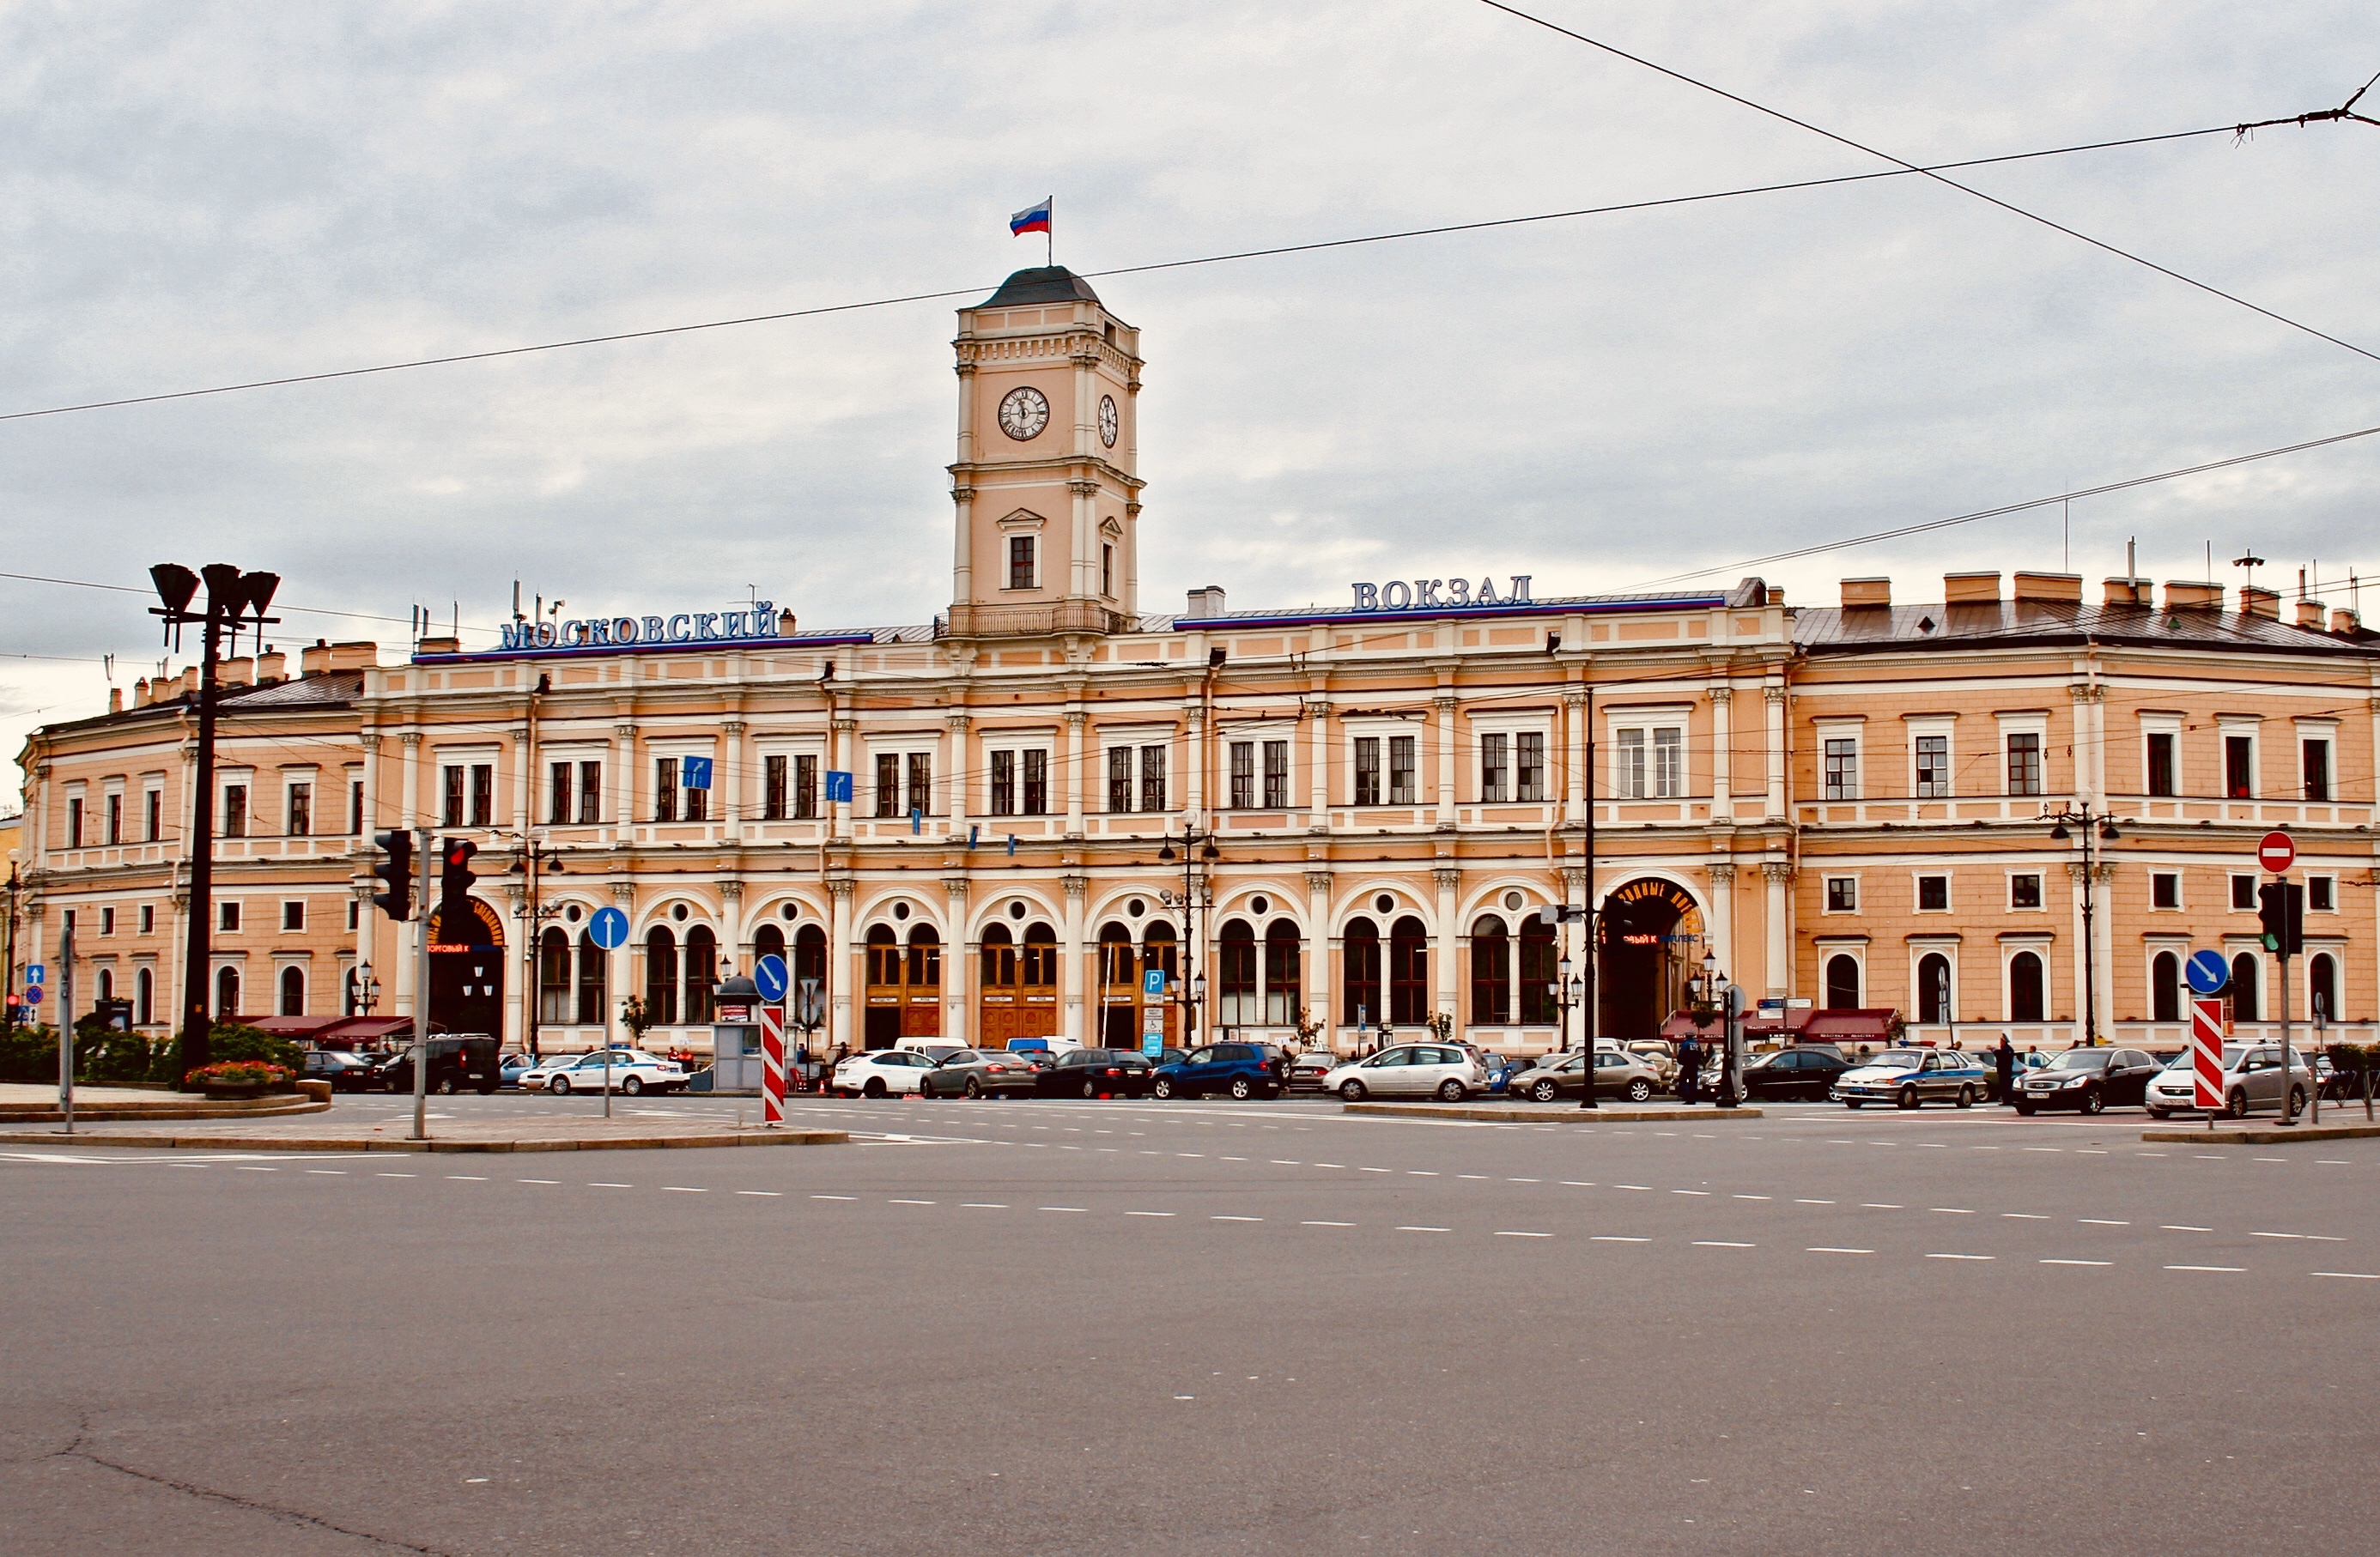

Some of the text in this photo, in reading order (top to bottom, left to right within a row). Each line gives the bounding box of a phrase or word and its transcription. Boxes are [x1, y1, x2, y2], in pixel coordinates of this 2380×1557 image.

[501, 575, 1532, 650] МОСКОВСКИЙ ВОКЗАЛ
[1149, 972, 1160, 991] P
